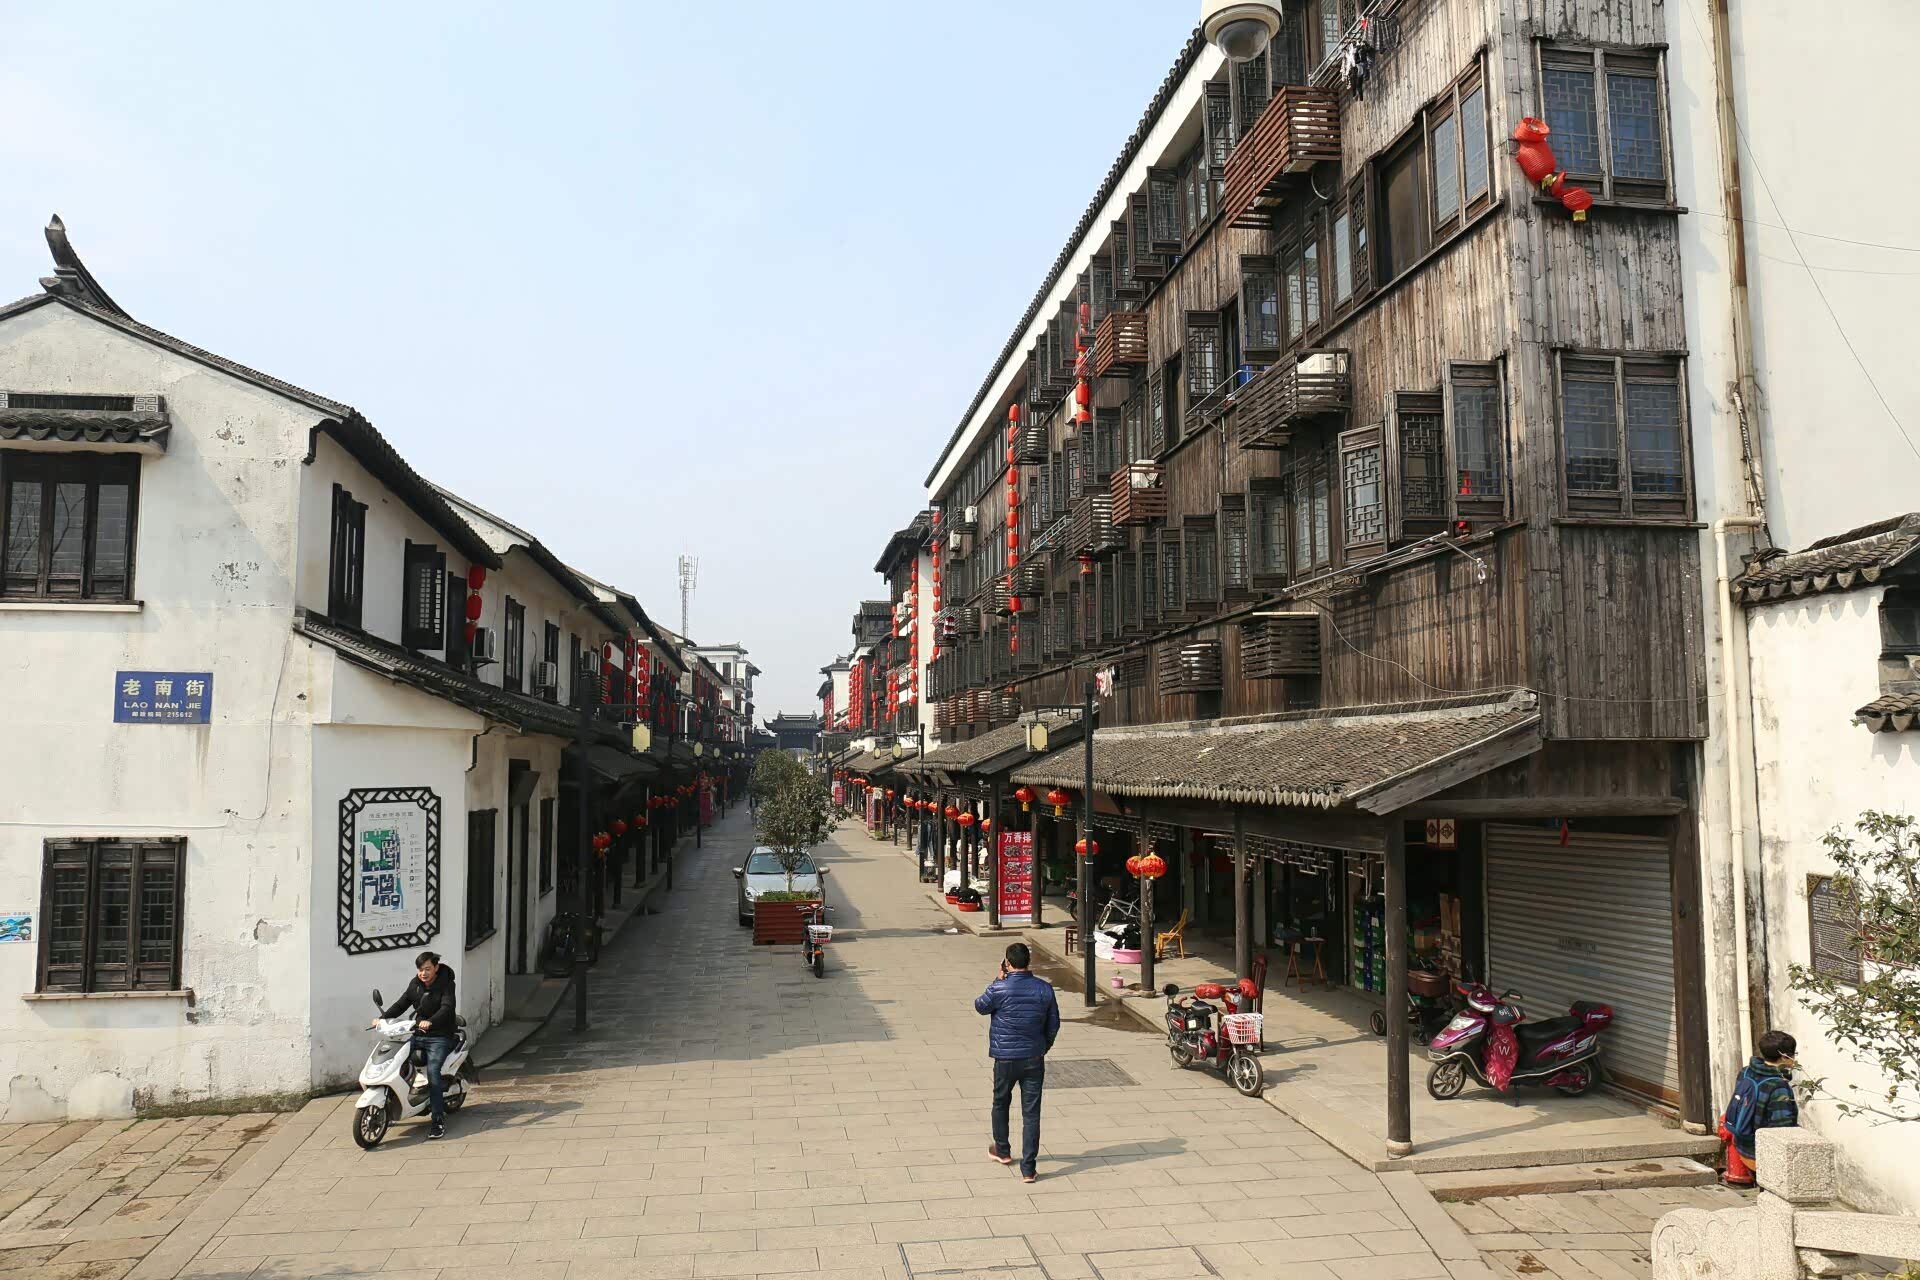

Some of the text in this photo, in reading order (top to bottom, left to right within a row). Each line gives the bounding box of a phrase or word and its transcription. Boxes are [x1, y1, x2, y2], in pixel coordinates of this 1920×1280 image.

[122, 679, 205, 697] 老南街
[1498, 1045, 1510, 1056] W
